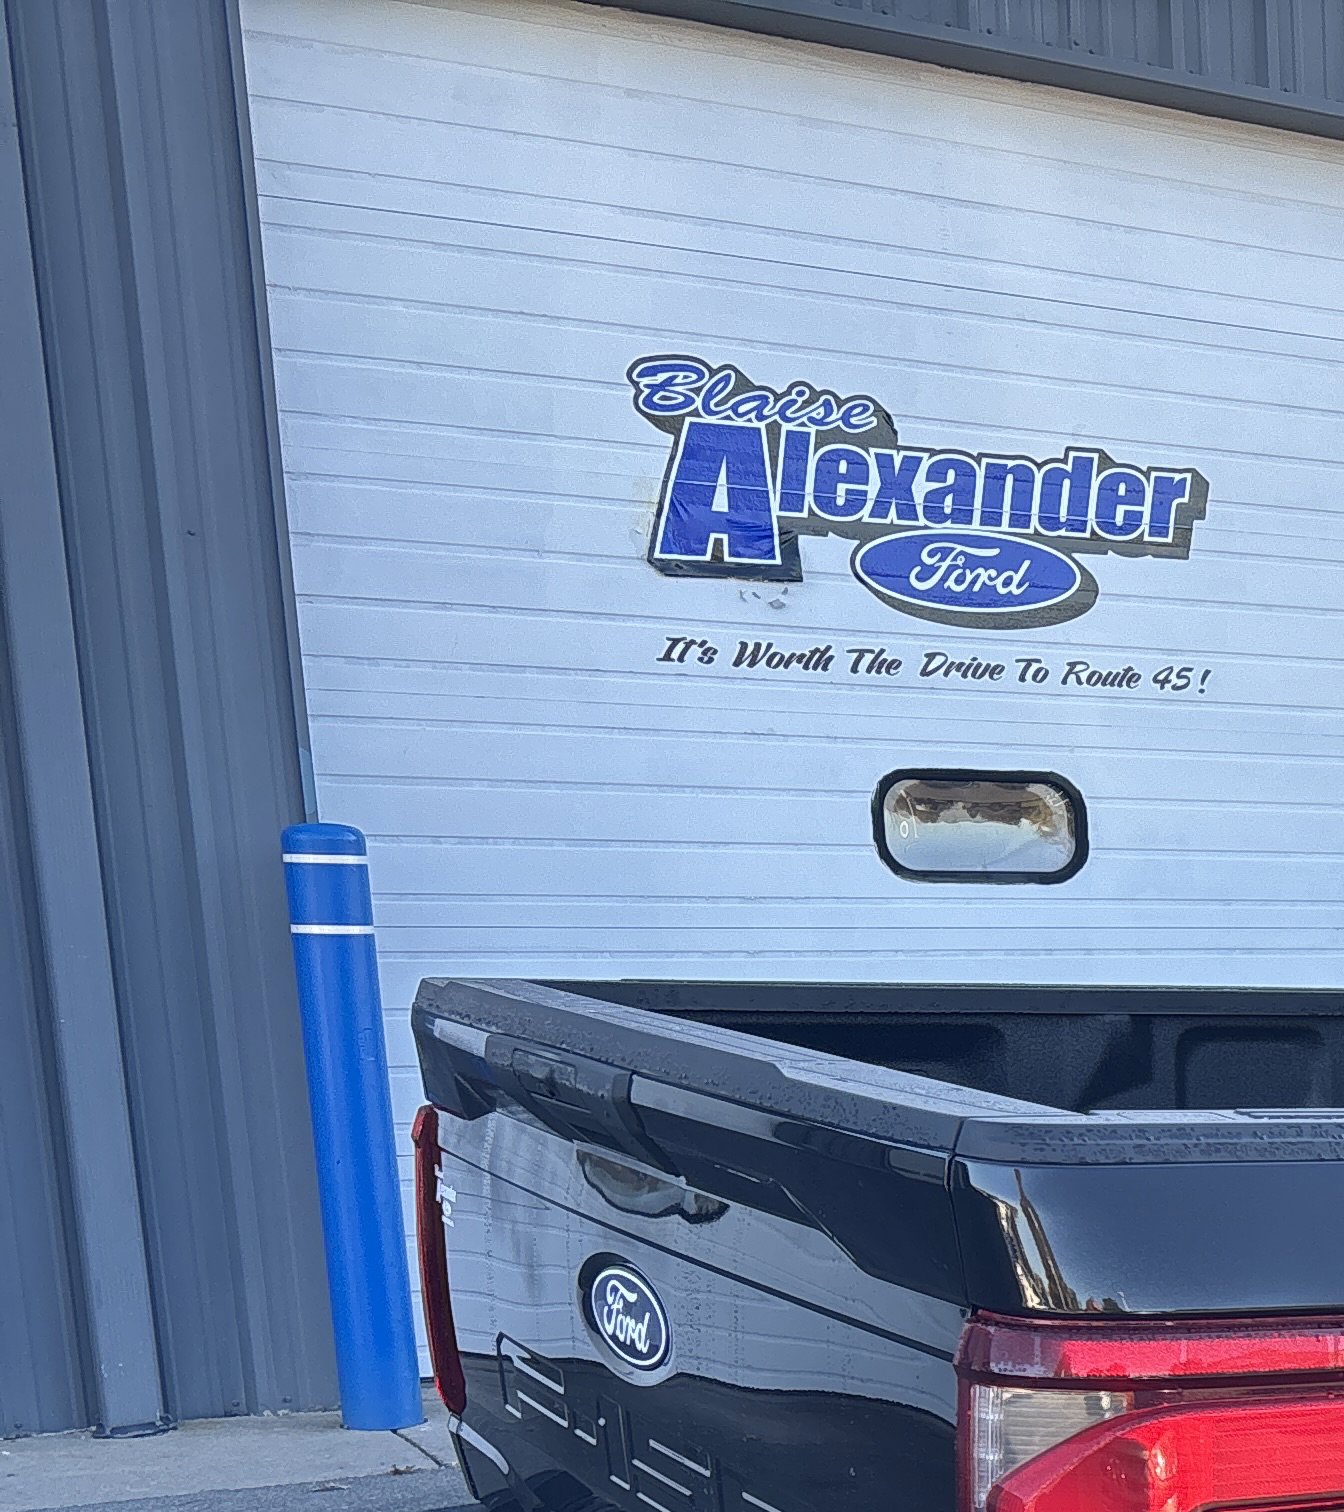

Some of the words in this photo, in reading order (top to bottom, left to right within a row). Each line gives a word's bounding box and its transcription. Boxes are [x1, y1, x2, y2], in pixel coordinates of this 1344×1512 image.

[631, 360, 878, 433] Blaise
[653, 417, 1192, 565] Alexander
[908, 542, 1031, 596] Ford
[655, 636, 719, 665] It's
[731, 640, 836, 673] Worth
[845, 647, 903, 676] The
[918, 651, 1006, 681] Drive
[1014, 657, 1050, 683] To
[1060, 660, 1142, 690] Route
[603, 1279, 651, 1354] Ford
